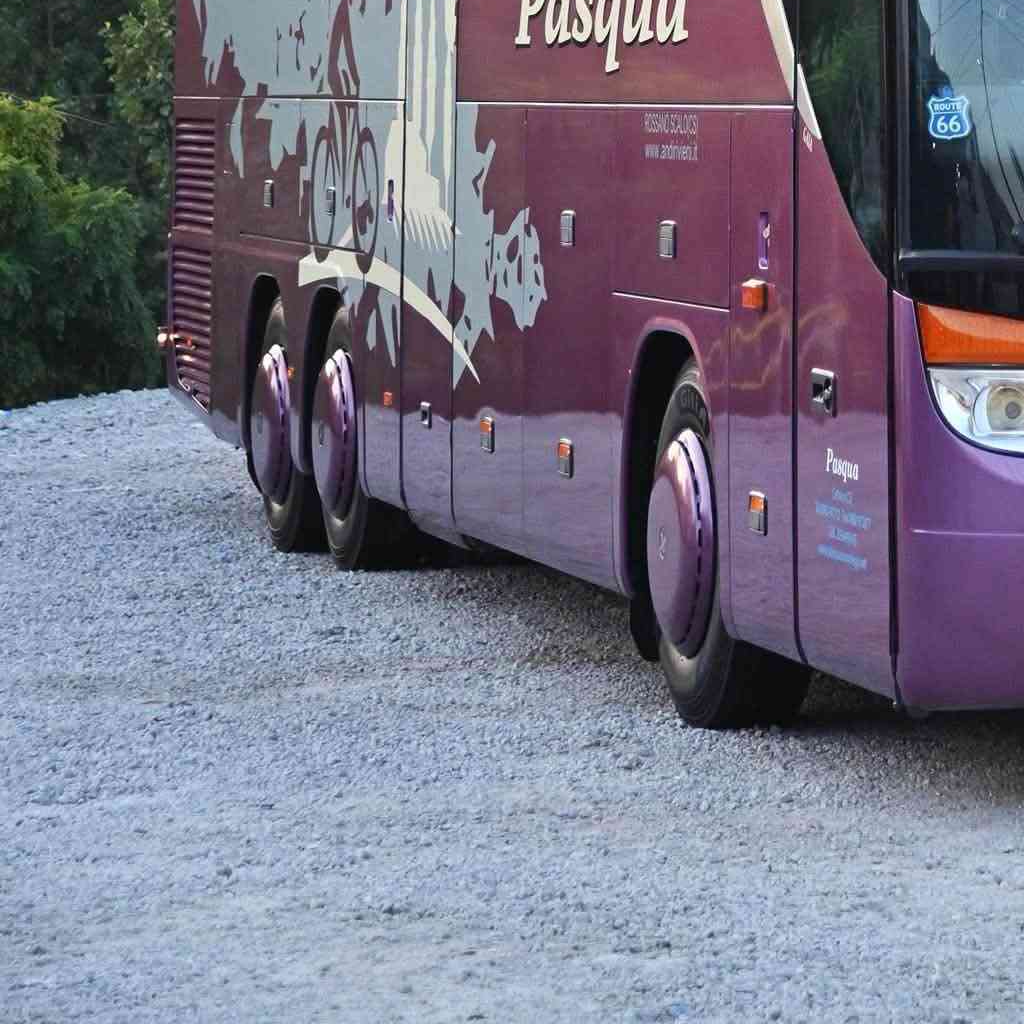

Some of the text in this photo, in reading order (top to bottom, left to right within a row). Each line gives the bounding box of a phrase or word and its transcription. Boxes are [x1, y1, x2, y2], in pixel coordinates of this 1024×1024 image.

[934, 103, 962, 112] ROUTE
[937, 115, 961, 133] 66
[826, 448, 859, 482] Pasqua
